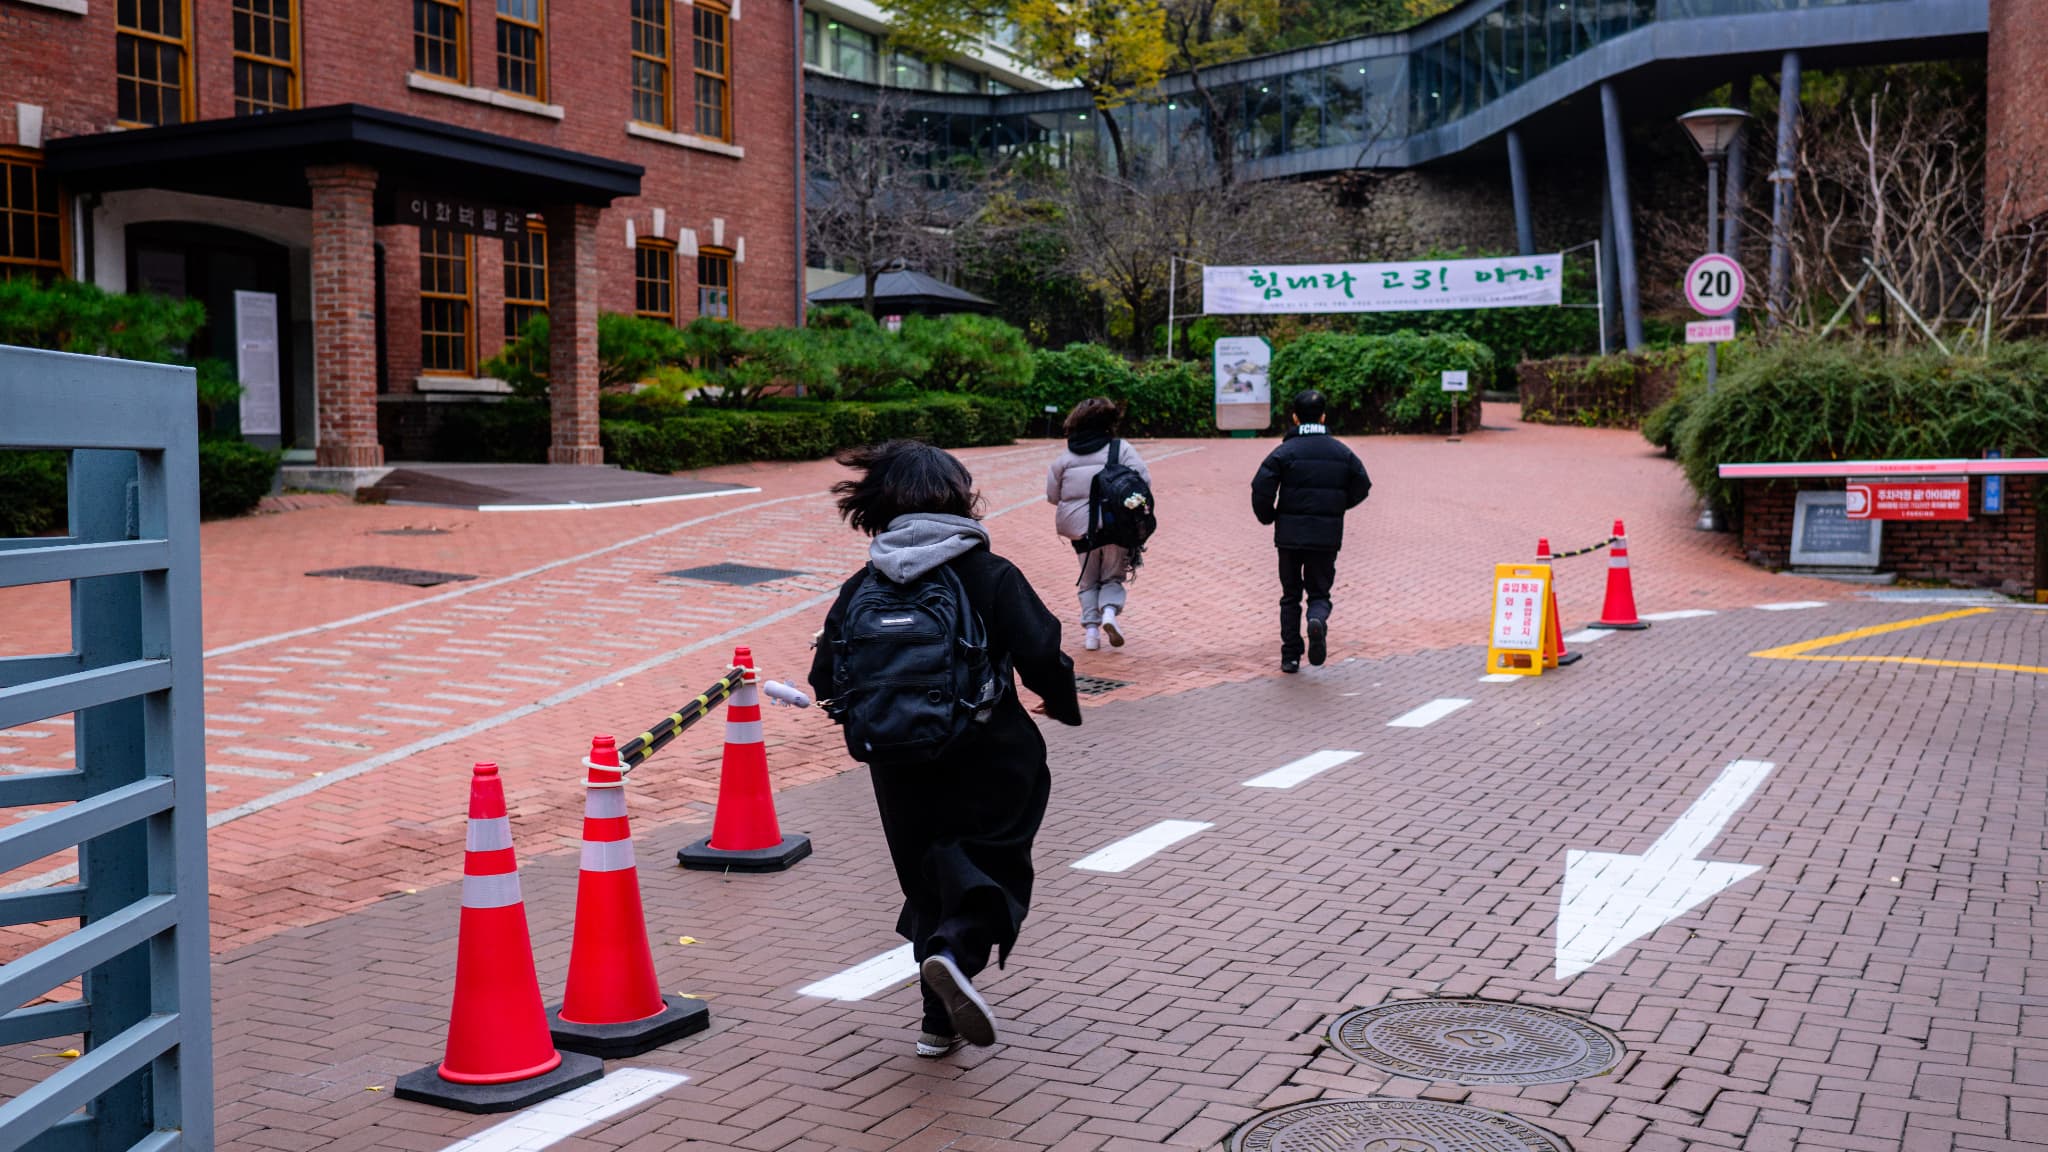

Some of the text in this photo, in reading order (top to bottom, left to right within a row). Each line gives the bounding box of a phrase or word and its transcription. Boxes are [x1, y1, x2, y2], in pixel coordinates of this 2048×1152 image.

[411, 200, 519, 233] 이화박물관
[1248, 269, 1357, 300] 힘내라
[1381, 266, 1449, 292] 고3!
[1699, 270, 1731, 297] 20
